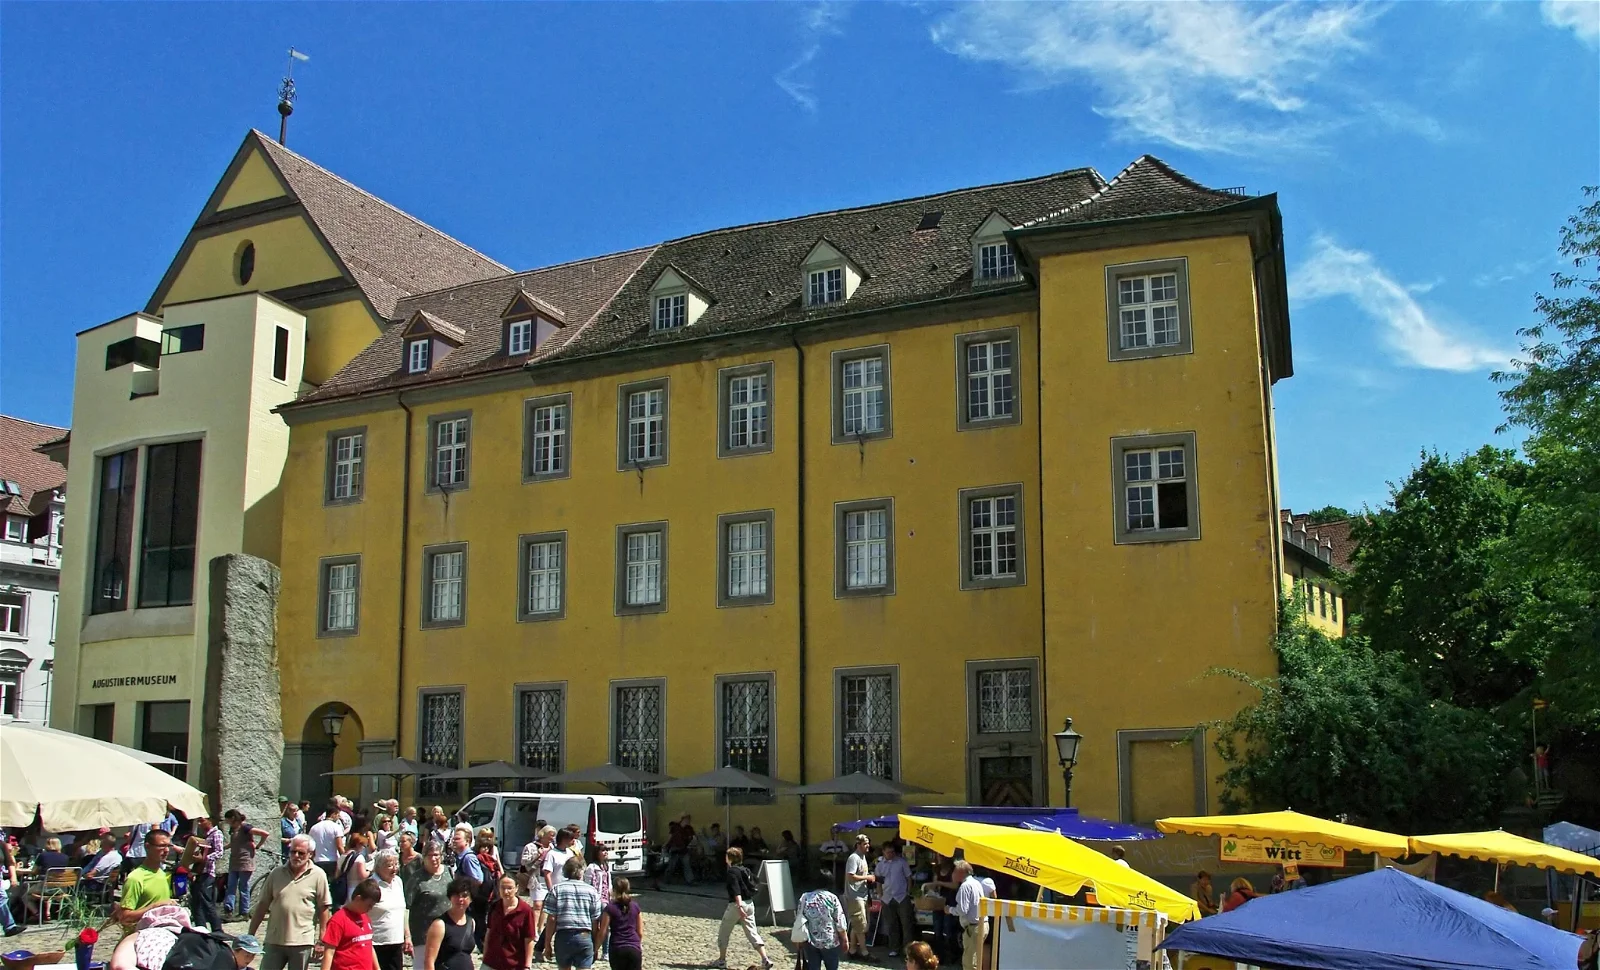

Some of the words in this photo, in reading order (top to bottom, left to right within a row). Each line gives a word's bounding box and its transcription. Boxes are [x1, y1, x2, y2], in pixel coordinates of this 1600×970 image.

[92, 675, 177, 689] AUGUSTINERMUSEUM
[1265, 847, 1302, 860] Witt
[1005, 859, 1038, 876] PLENUM
[1129, 896, 1155, 909] PLENUM
